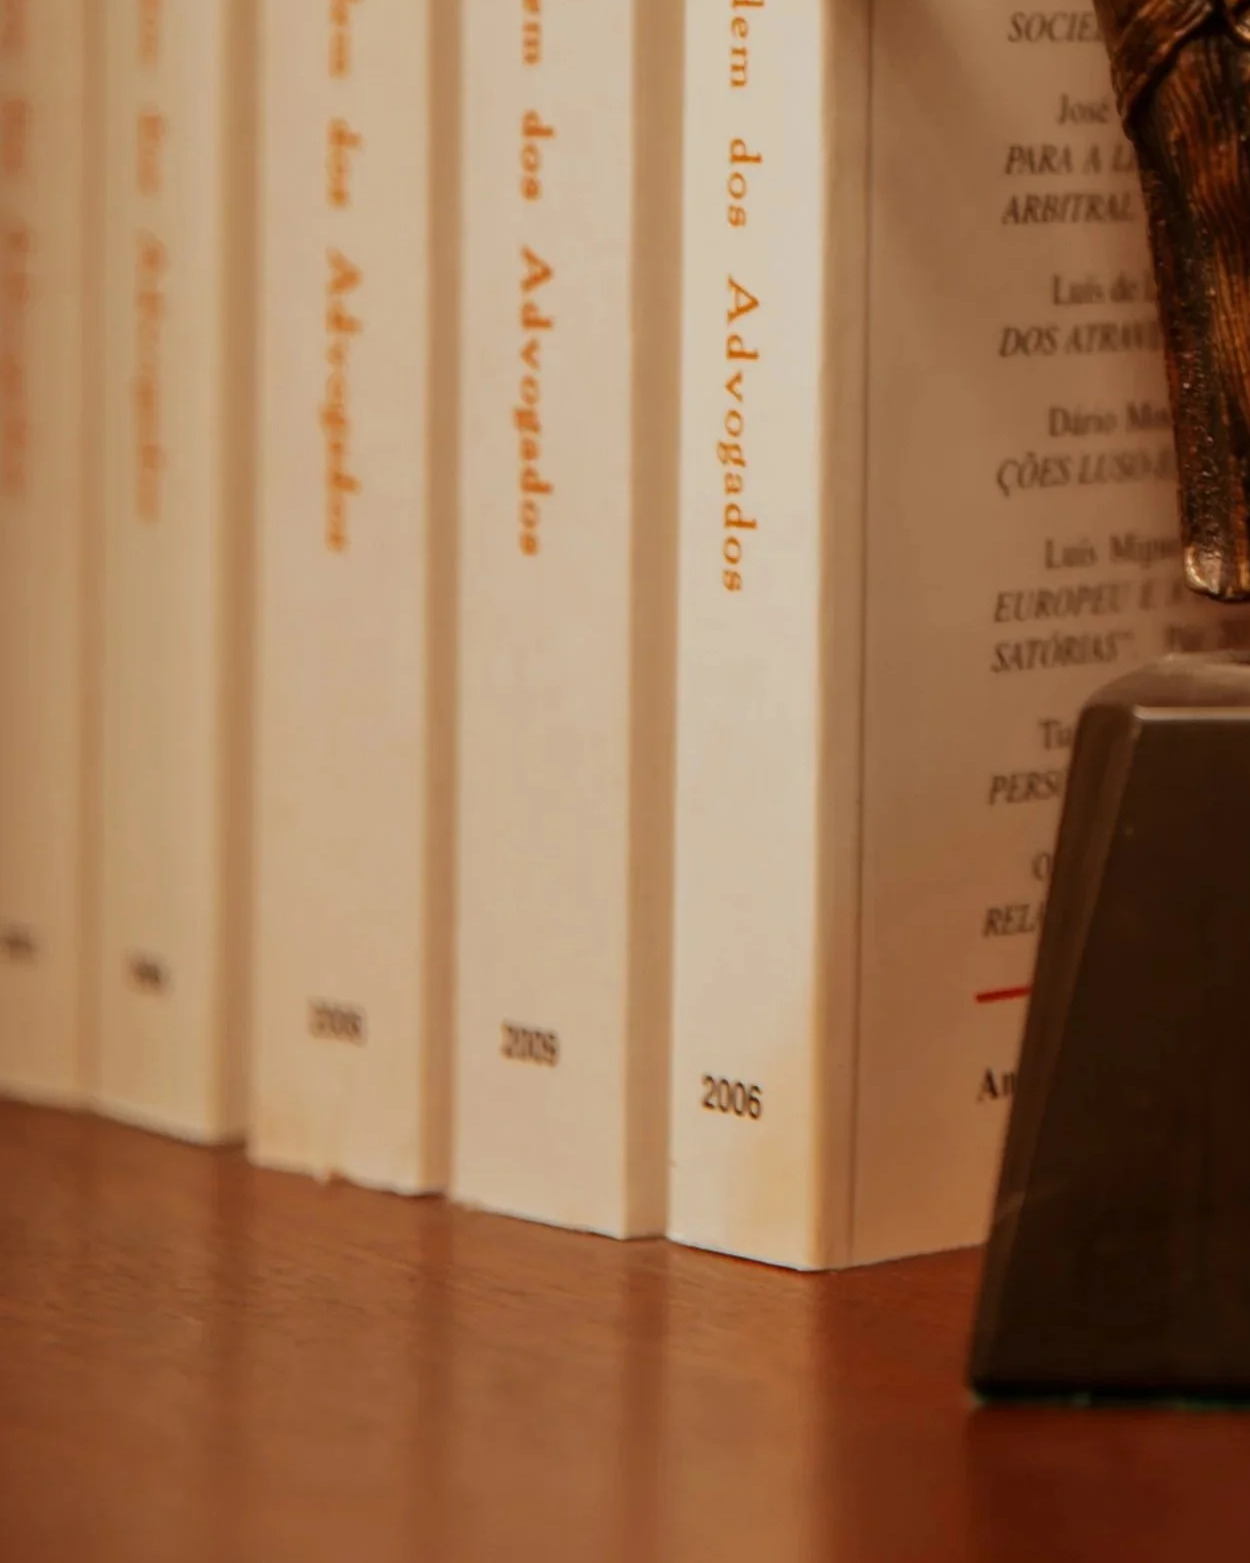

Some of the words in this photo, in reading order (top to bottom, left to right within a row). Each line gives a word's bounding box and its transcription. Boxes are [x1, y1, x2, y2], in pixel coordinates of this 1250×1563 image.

[520, 109, 556, 202] dos
[726, 136, 764, 229] dos
[1004, 143, 1075, 176] PARA
[999, 323, 1060, 357] DOS
[513, 246, 554, 557] Advogados
[717, 275, 761, 594] Advogados
[701, 1075, 763, 1122] 2006
